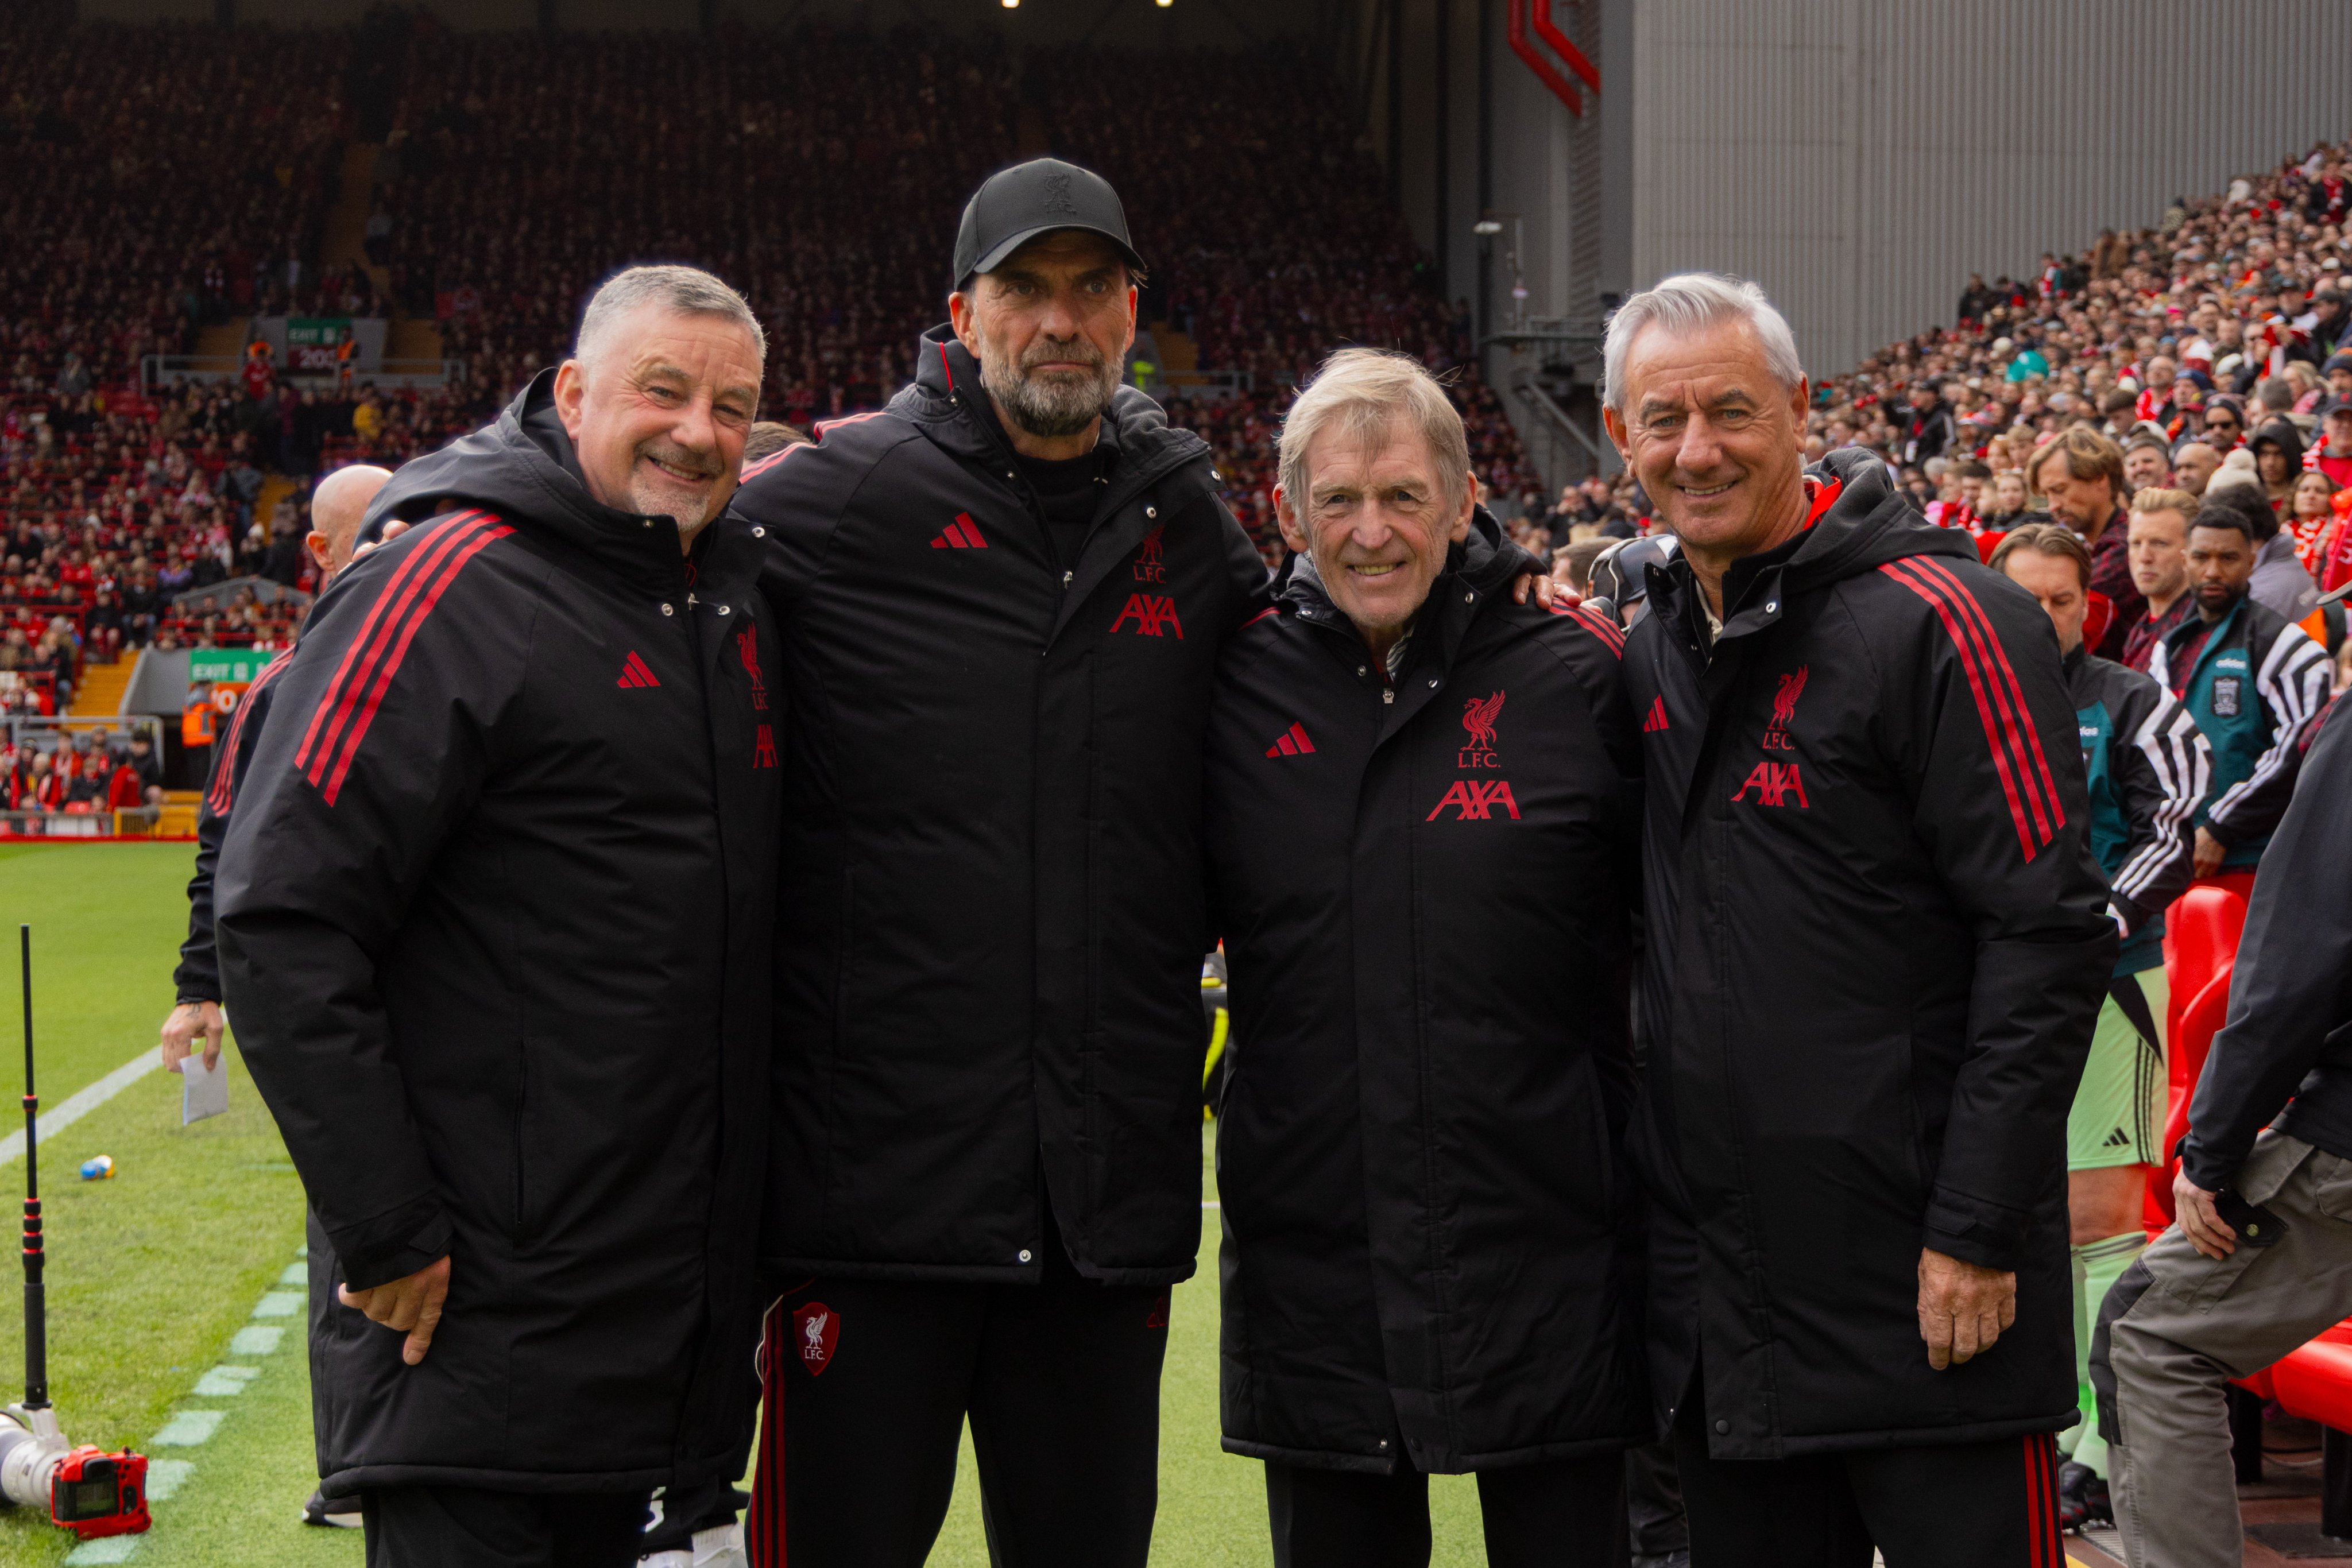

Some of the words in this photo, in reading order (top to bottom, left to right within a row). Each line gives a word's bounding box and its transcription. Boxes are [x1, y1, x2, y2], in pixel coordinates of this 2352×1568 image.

[1133, 565, 1167, 584] L.F.C.
[1109, 593, 1184, 640] AXA
[192, 663, 230, 680] EXIT
[1762, 733, 1795, 750] L.F.C.
[1458, 753, 1502, 768] L.F.C.
[1730, 761, 1809, 808] AXA
[1425, 780, 1522, 821] AXA
[804, 1349, 825, 1360] L.F.C.
